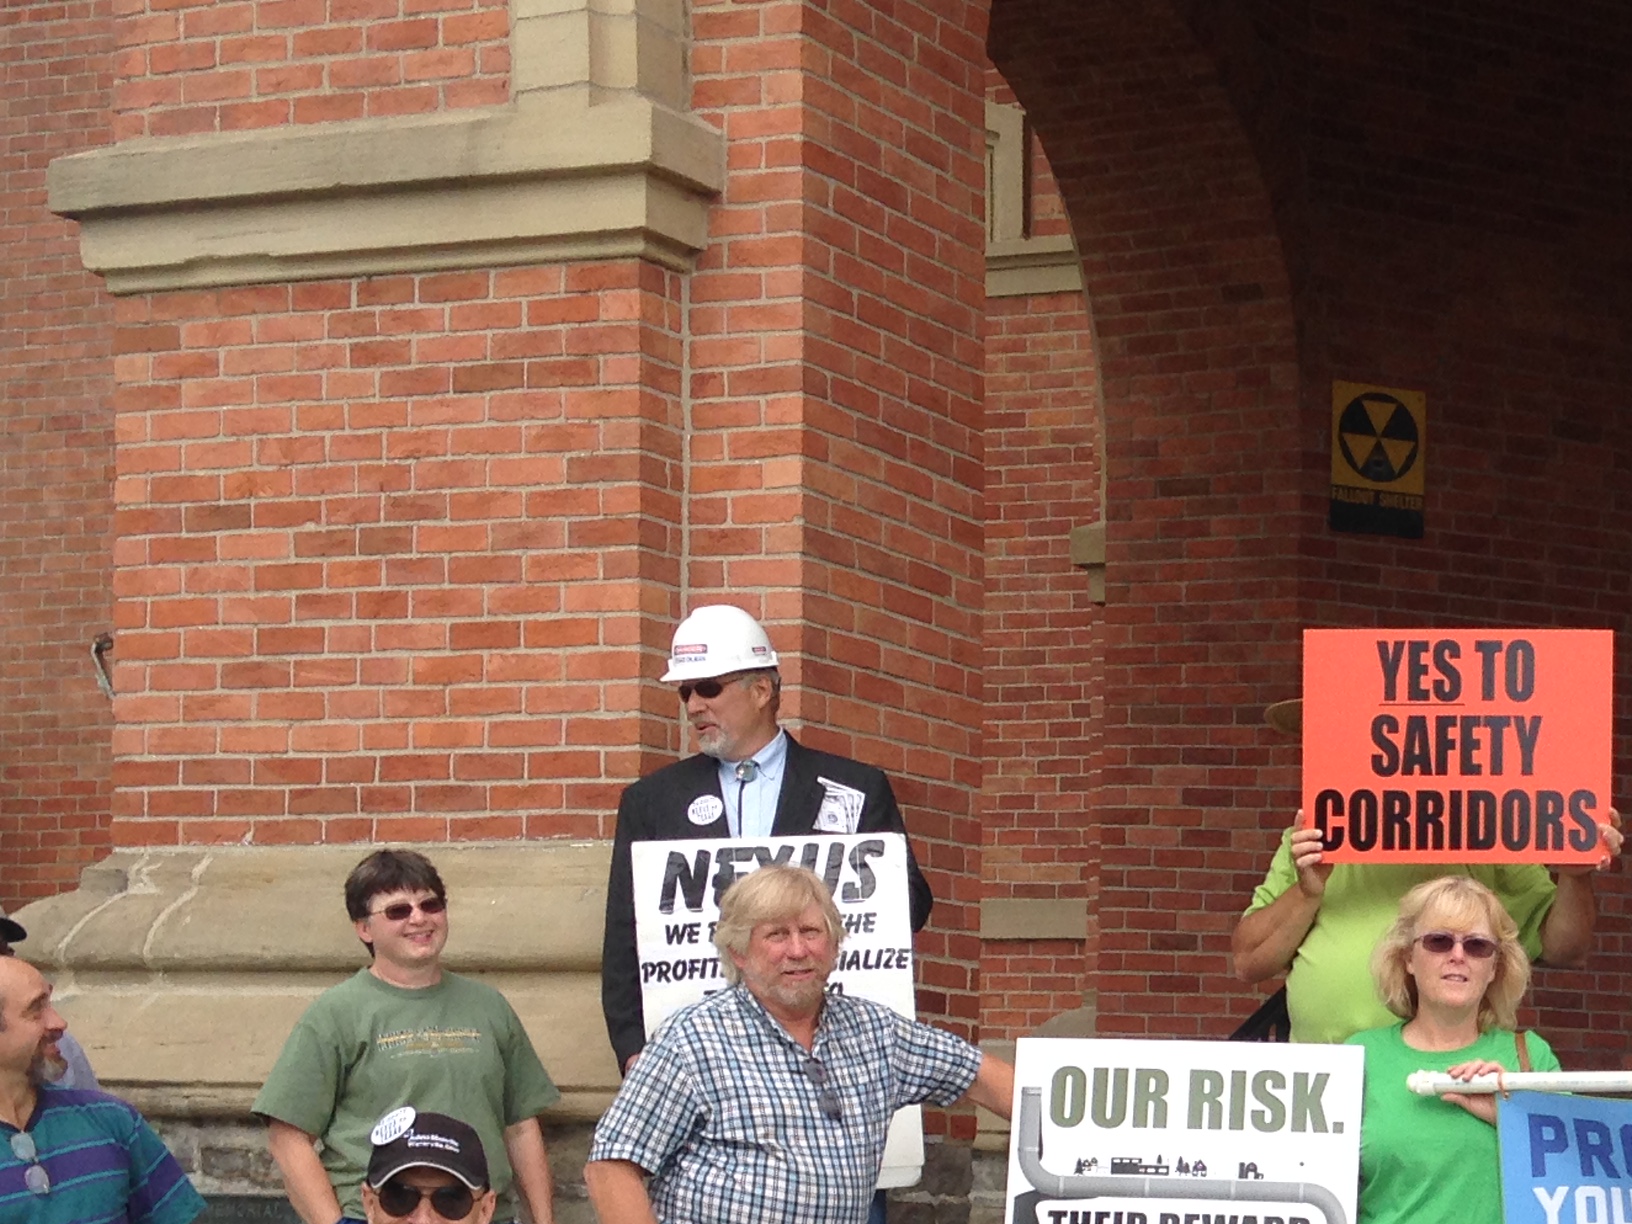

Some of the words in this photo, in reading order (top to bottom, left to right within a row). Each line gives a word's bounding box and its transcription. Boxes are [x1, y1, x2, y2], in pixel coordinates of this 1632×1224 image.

[1377, 639, 1462, 703] YES
[1475, 639, 1536, 702] TO
[1370, 714, 1543, 777] SAFETY
[1314, 788, 1597, 852] CORRIDORS
[665, 922, 701, 946] WE
[840, 912, 877, 934] HE
[1049, 1065, 1170, 1129] OUR
[1187, 1069, 1344, 1134] RISK.
